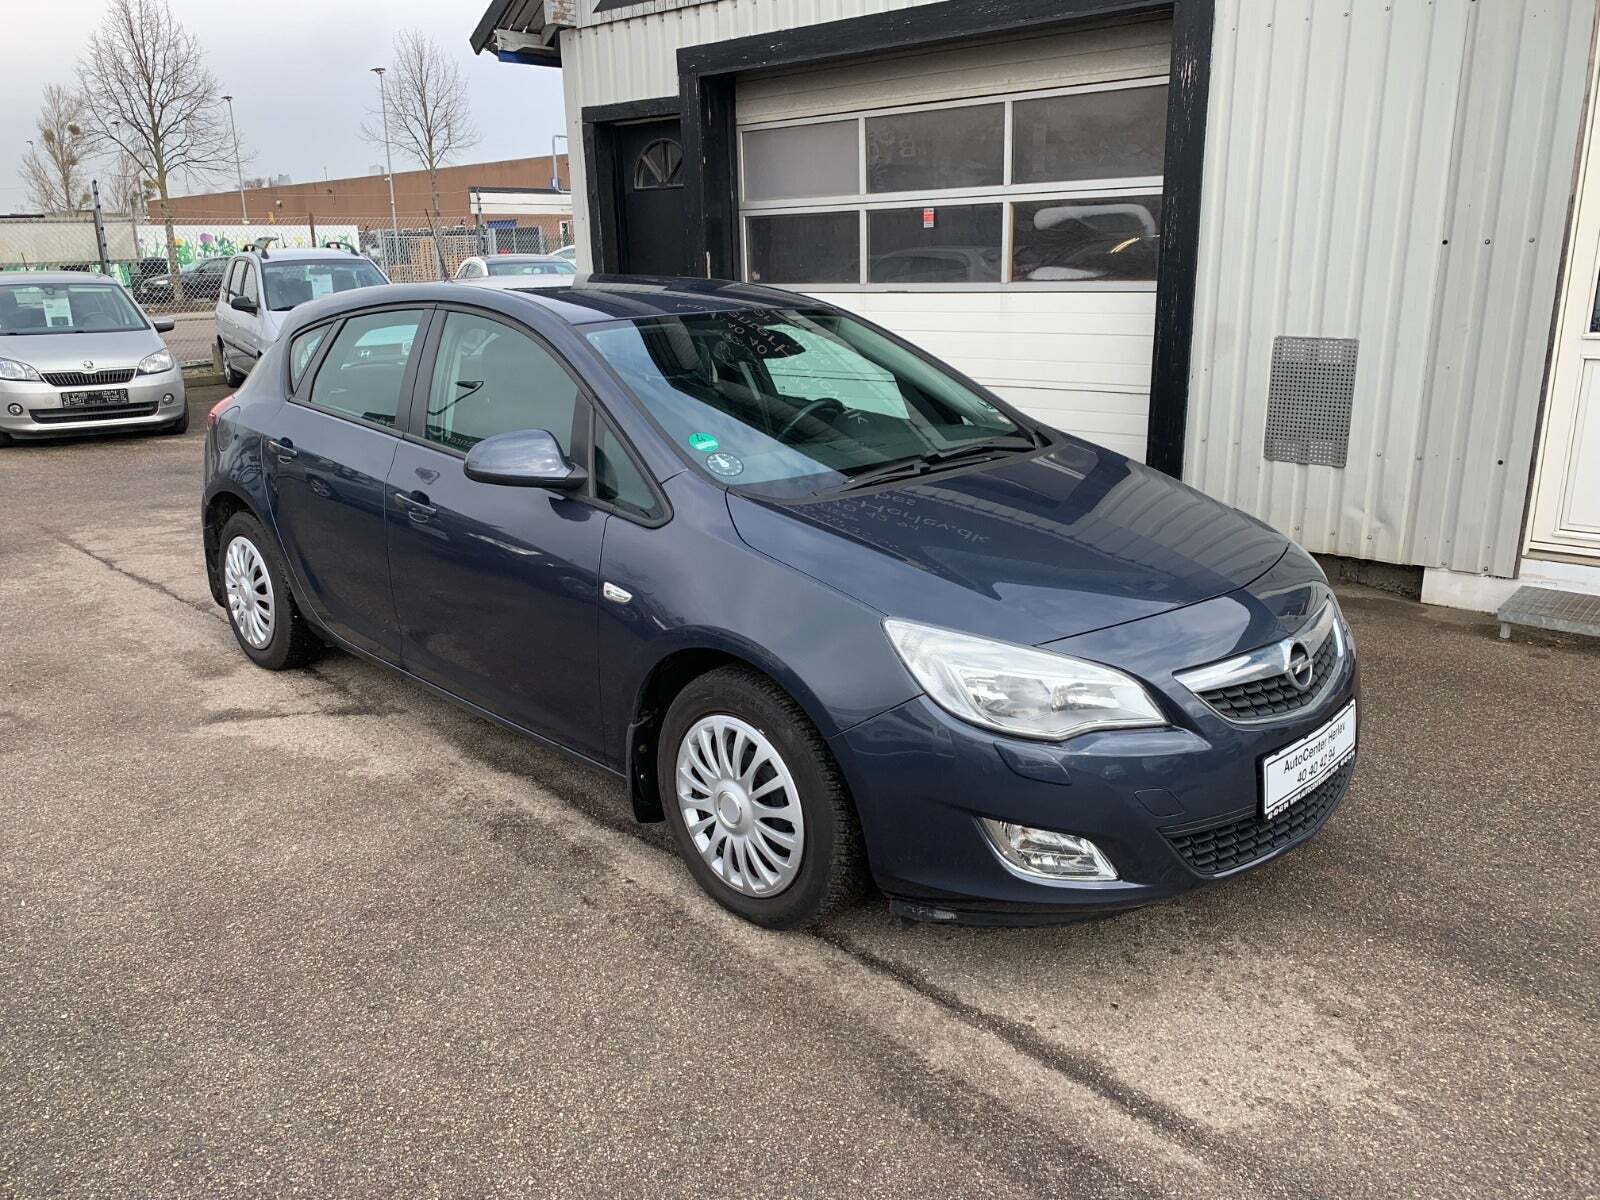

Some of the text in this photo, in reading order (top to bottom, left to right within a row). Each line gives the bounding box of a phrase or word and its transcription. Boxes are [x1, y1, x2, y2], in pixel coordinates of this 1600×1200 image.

[1283, 739, 1327, 774] AutoCenter
[1328, 722, 1345, 741] Herlev
[1297, 768, 1307, 782] 40
